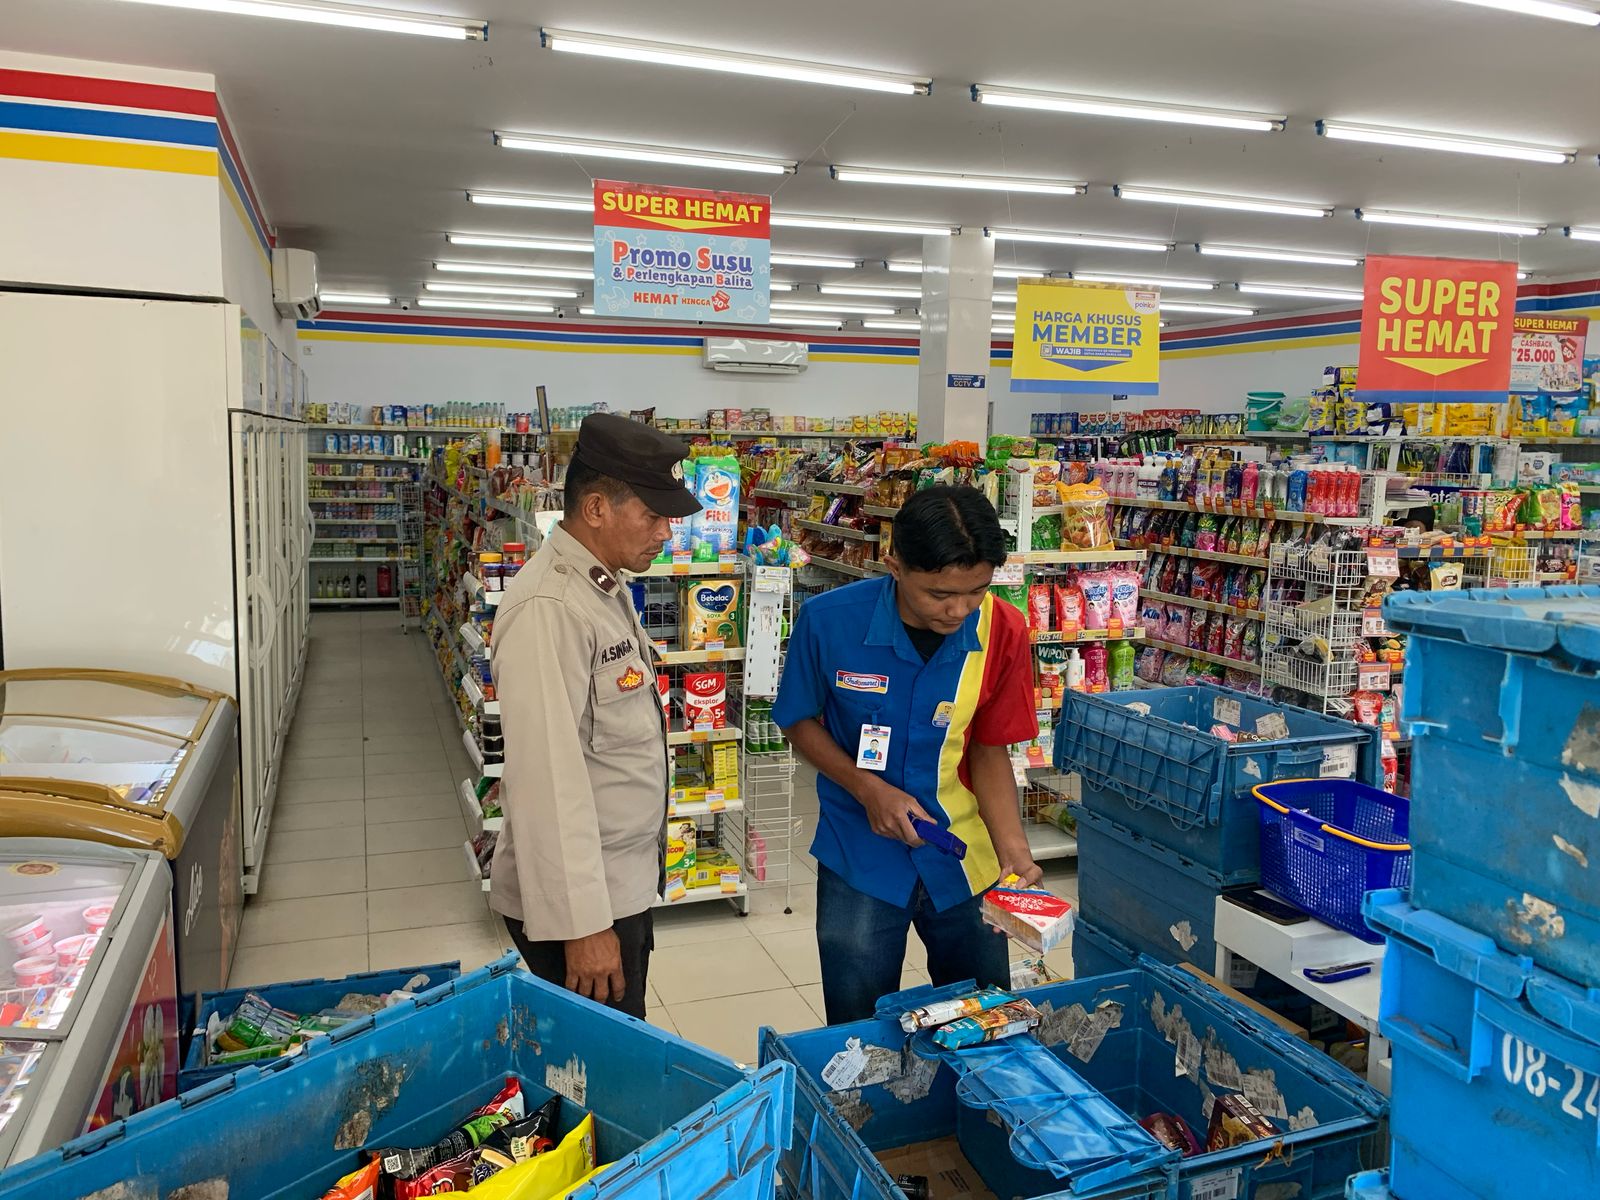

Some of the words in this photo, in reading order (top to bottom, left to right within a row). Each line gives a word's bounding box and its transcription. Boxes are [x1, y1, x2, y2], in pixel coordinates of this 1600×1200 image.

[602, 191, 679, 216] SUPER
[685, 199, 763, 224] HEMAT
[612, 240, 691, 268] Promo
[697, 246, 753, 273] Susu
[613, 267, 622, 280] &
[626, 268, 713, 287] Perlengkapan
[715, 275, 753, 288] Balita
[633, 291, 679, 306] HEMAT
[681, 298, 711, 307] HINGGA
[1379, 276, 1501, 318] SUPER
[1033, 310, 1083, 324] HARGA
[1086, 313, 1142, 326] KHUSUS
[1514, 317, 1544, 329] SUPER
[1546, 319, 1579, 331] HEMAT
[1032, 323, 1142, 347] MEMBER
[1376, 317, 1498, 354] HEMAT
[1055, 347, 1082, 355] WAJIB
[1520, 340, 1553, 348] CASHBACK
[1516, 348, 1556, 363] 25.000
[705, 509, 731, 522] Fitti
[700, 594, 729, 602] Bebelac
[730, 612, 735, 620] 3
[695, 677, 717, 691] SGM
[845, 677, 878, 687] Indomaret
[714, 708, 725, 719] 5+
[683, 858, 695, 868] 3+
